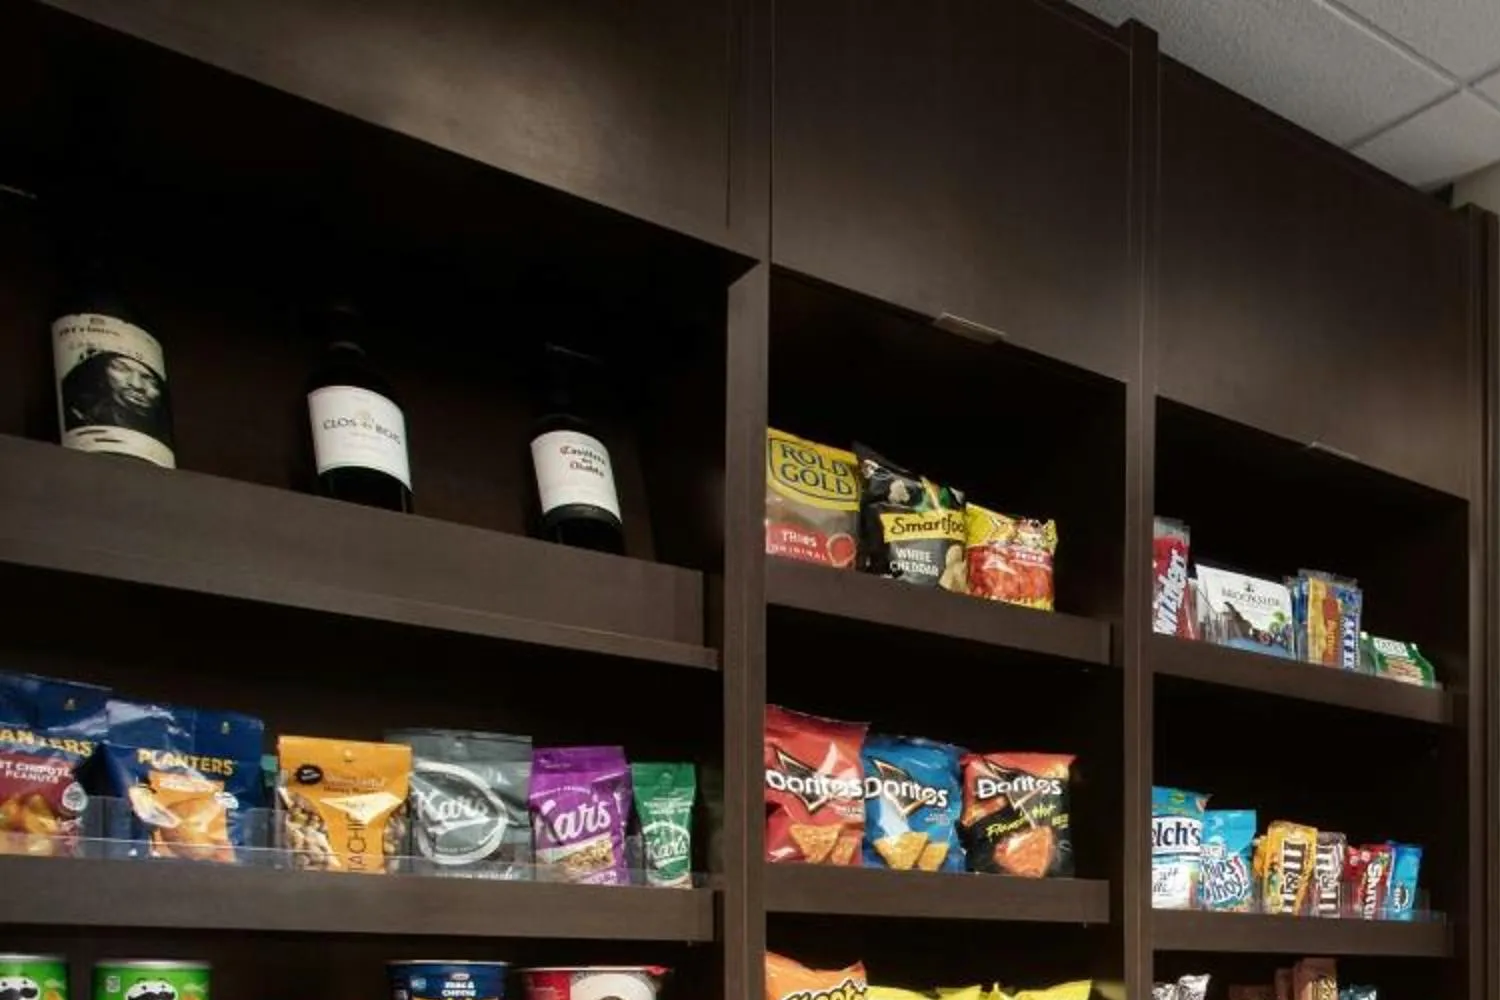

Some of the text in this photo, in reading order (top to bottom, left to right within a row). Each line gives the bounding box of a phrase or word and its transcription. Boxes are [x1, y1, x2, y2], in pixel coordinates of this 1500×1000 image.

[781, 443, 850, 477] ROLD
[780, 461, 852, 496] GOLD
[137, 747, 236, 776] PLANTERS
[765, 767, 863, 799] Doritos
[864, 775, 949, 808] Doritos
[977, 775, 1064, 800] Doritos
